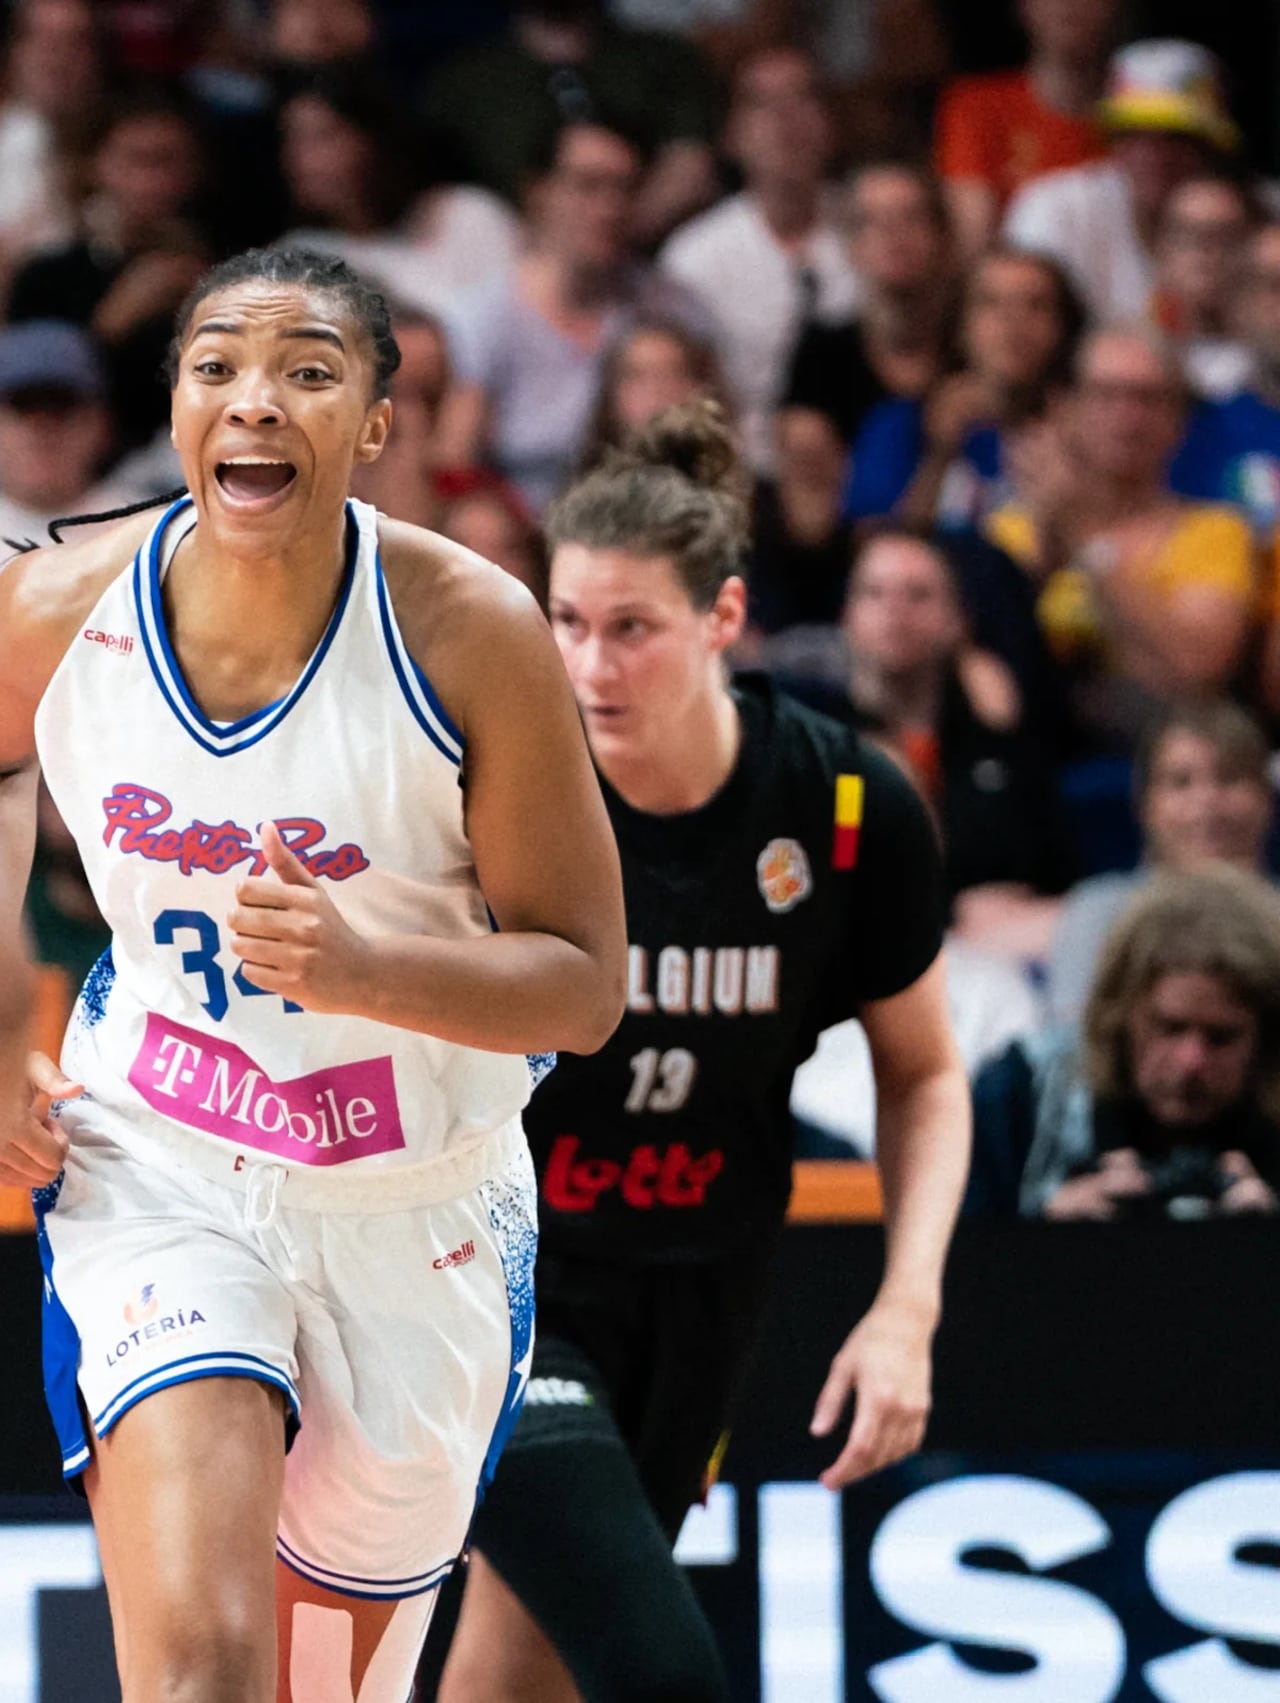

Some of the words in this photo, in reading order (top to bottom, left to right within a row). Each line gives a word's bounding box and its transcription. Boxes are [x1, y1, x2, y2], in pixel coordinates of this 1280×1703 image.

[102, 783, 253, 876] Puerto
[247, 816, 371, 882] Rco
[627, 943, 781, 1016] LGIUM
[624, 1047, 697, 1113] 13
